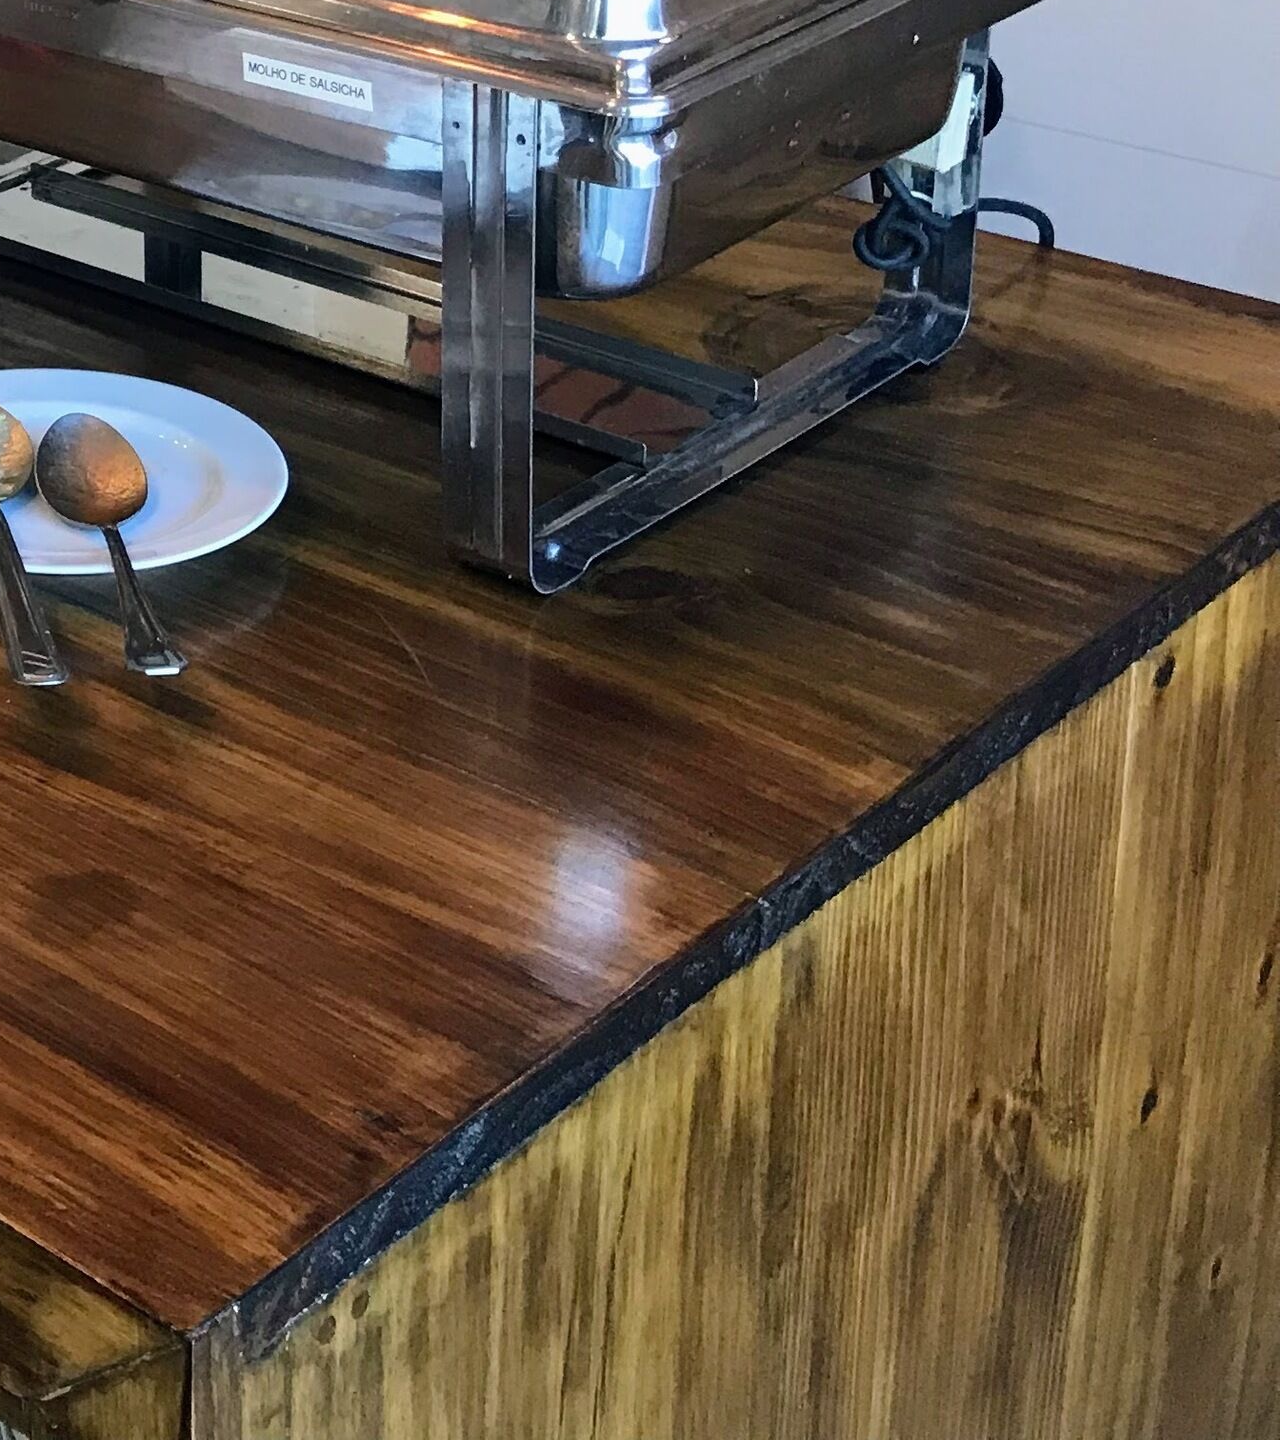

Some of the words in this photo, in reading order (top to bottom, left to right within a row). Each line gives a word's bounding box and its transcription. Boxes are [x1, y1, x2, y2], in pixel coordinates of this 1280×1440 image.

[248, 61, 287, 81] MOLHO
[290, 71, 306, 86] DE
[309, 76, 366, 100] SALSICHA
